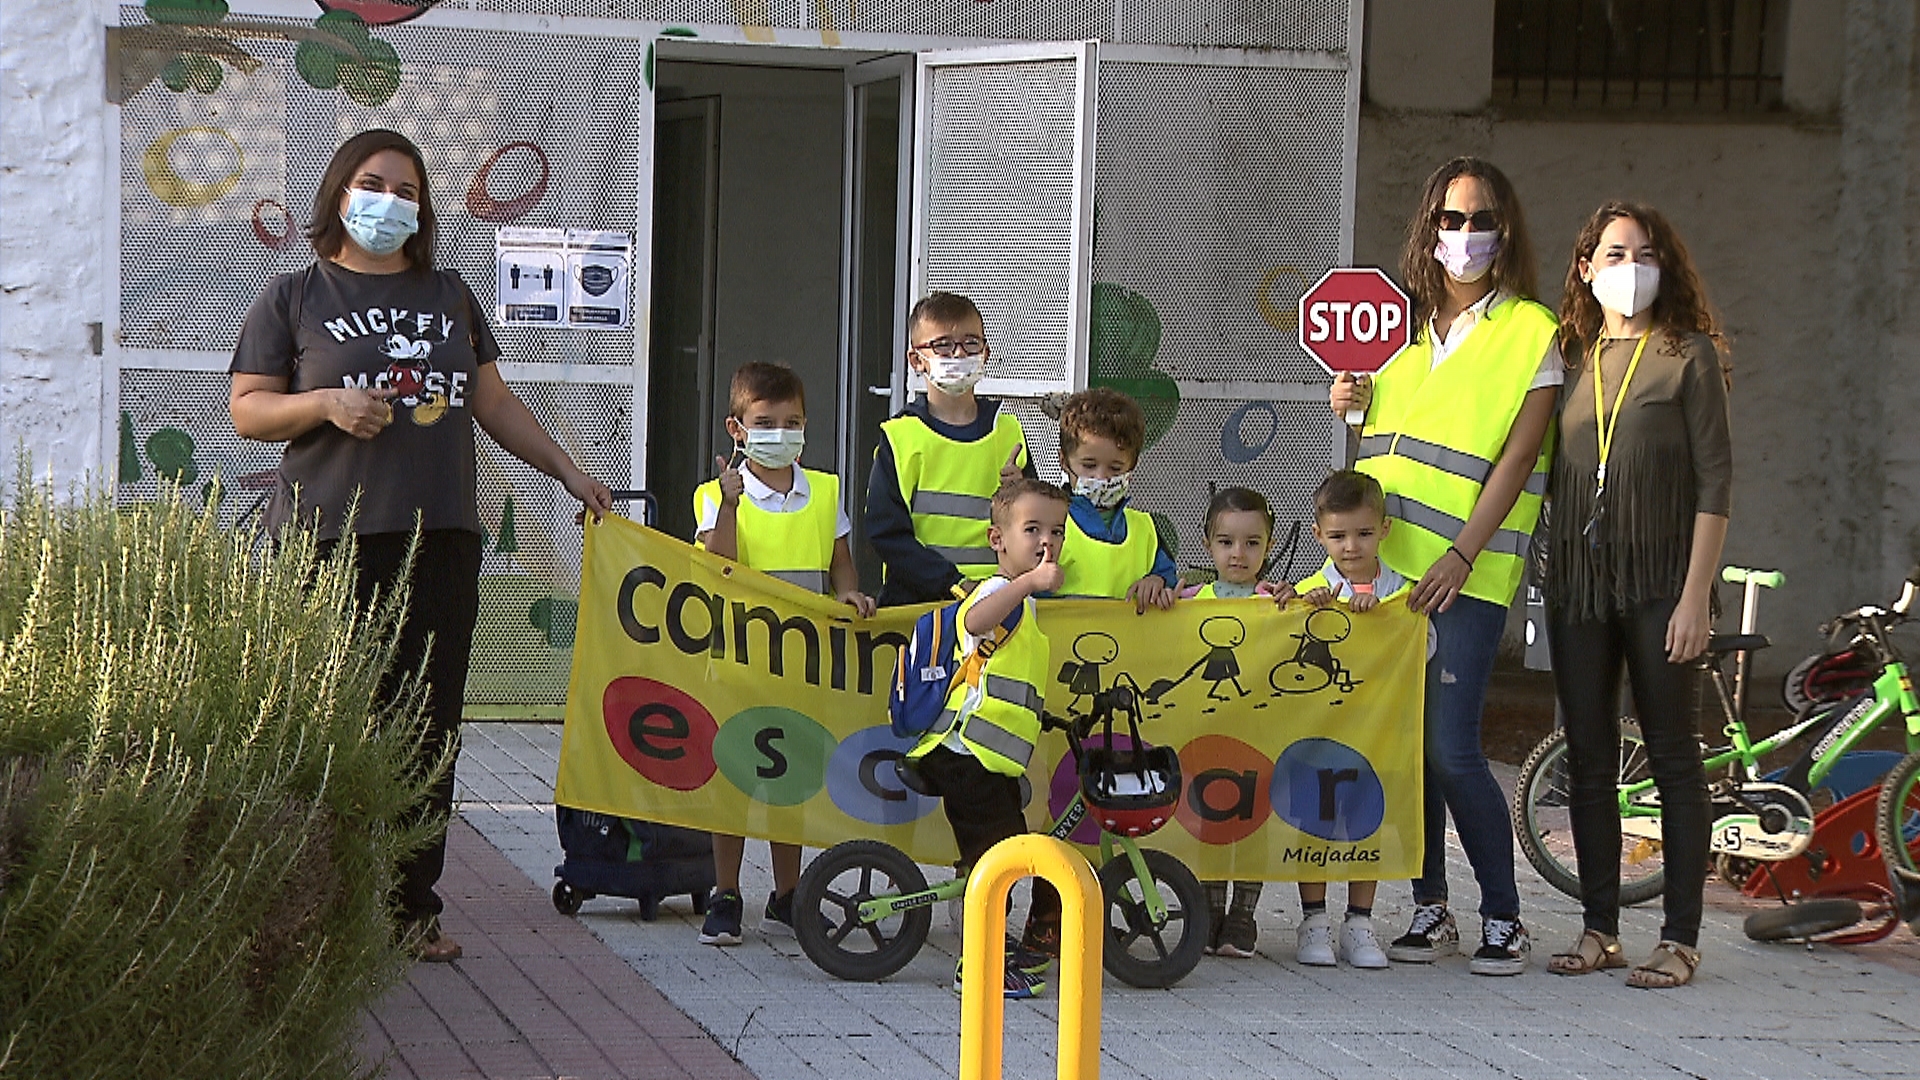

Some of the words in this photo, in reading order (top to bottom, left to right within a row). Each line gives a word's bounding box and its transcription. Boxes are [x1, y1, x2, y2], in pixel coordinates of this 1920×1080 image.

[324, 307, 455, 344] MICKEY
[1309, 301, 1402, 343] STOP
[616, 565, 912, 696] camin
[627, 701, 1359, 823] escar
[1054, 803, 1086, 838] WYER
[1282, 845, 1381, 868] Miajadas
